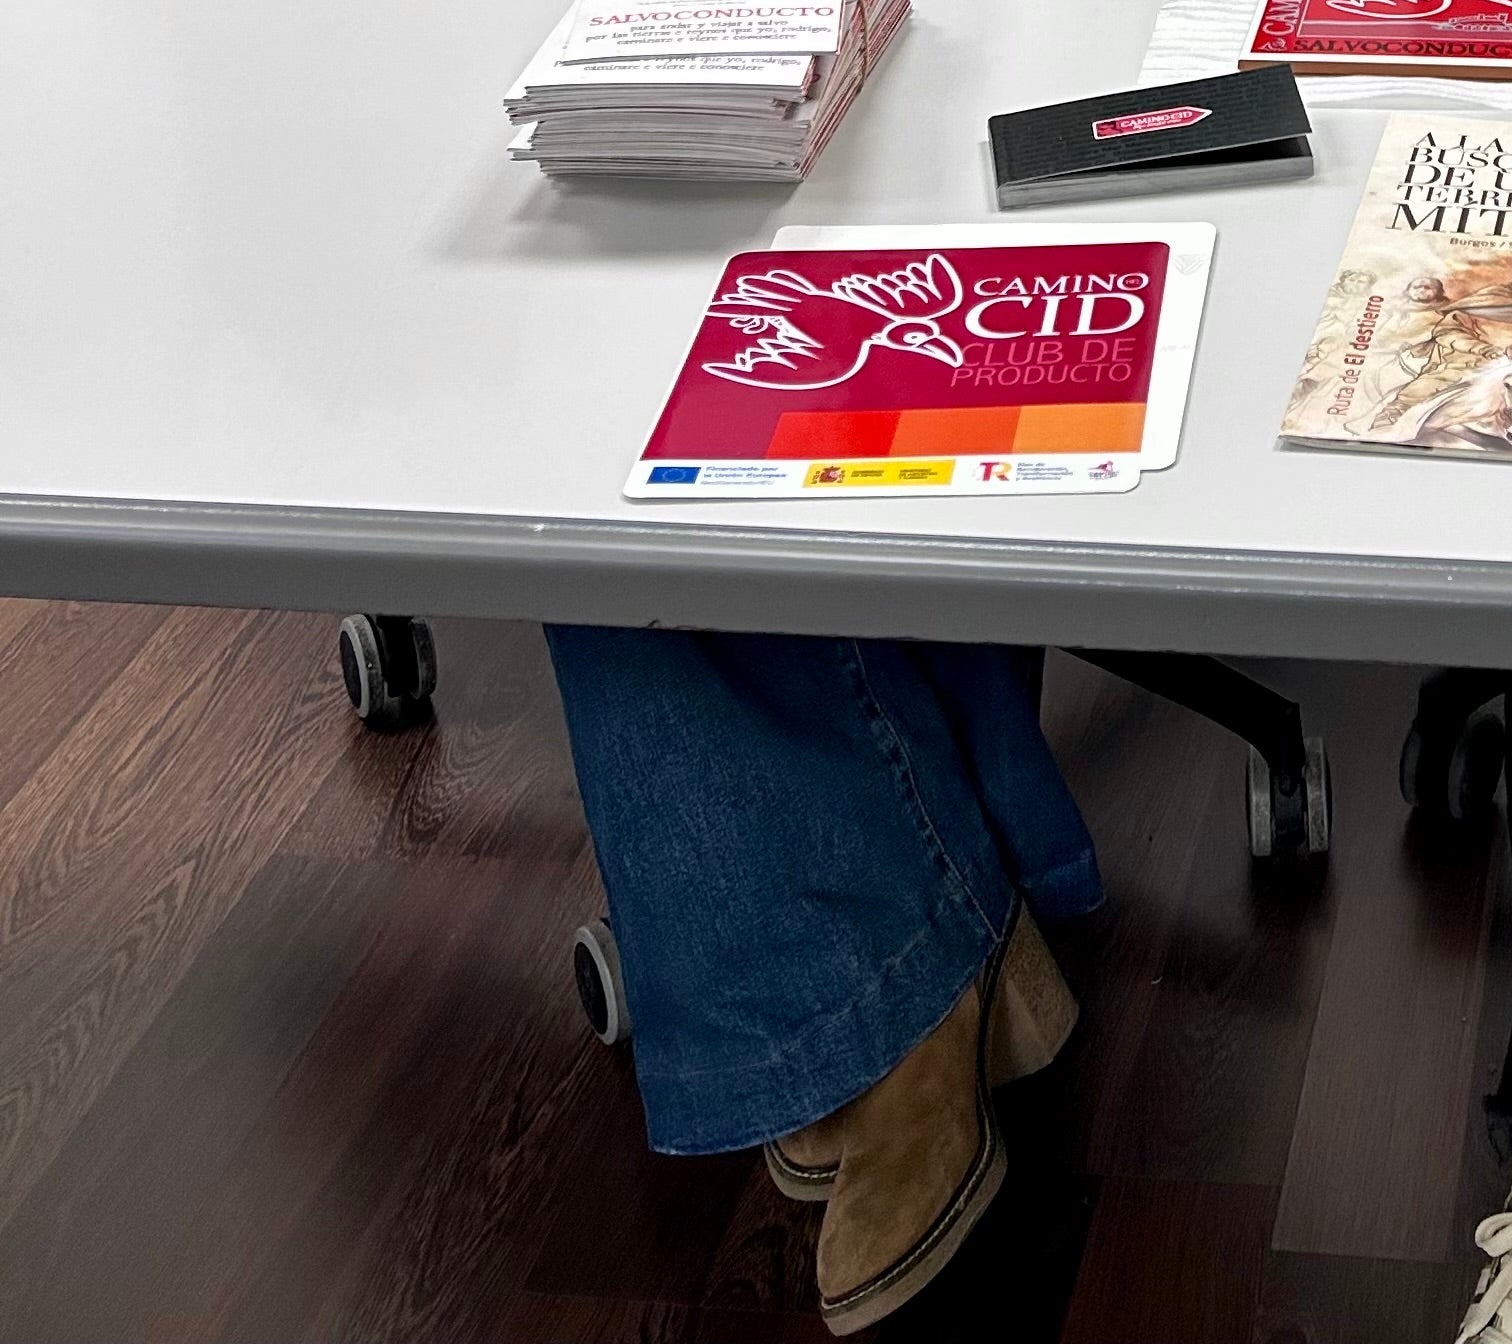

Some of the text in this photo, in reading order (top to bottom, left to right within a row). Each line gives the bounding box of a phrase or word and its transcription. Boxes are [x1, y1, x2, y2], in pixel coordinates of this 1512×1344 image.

[589, 7, 835, 27] SALVOCONDUCTO
[1414, 131, 1505, 153] A LA
[1401, 163, 1475, 188] DE
[1449, 238, 1496, 250] Burgos
[973, 272, 1150, 297] CAMINO
[964, 292, 1146, 339] CID
[962, 337, 1137, 367] CLUB DE
[1327, 295, 1385, 416] Ruta de El destierro
[950, 363, 1132, 388] PRODUCTO
